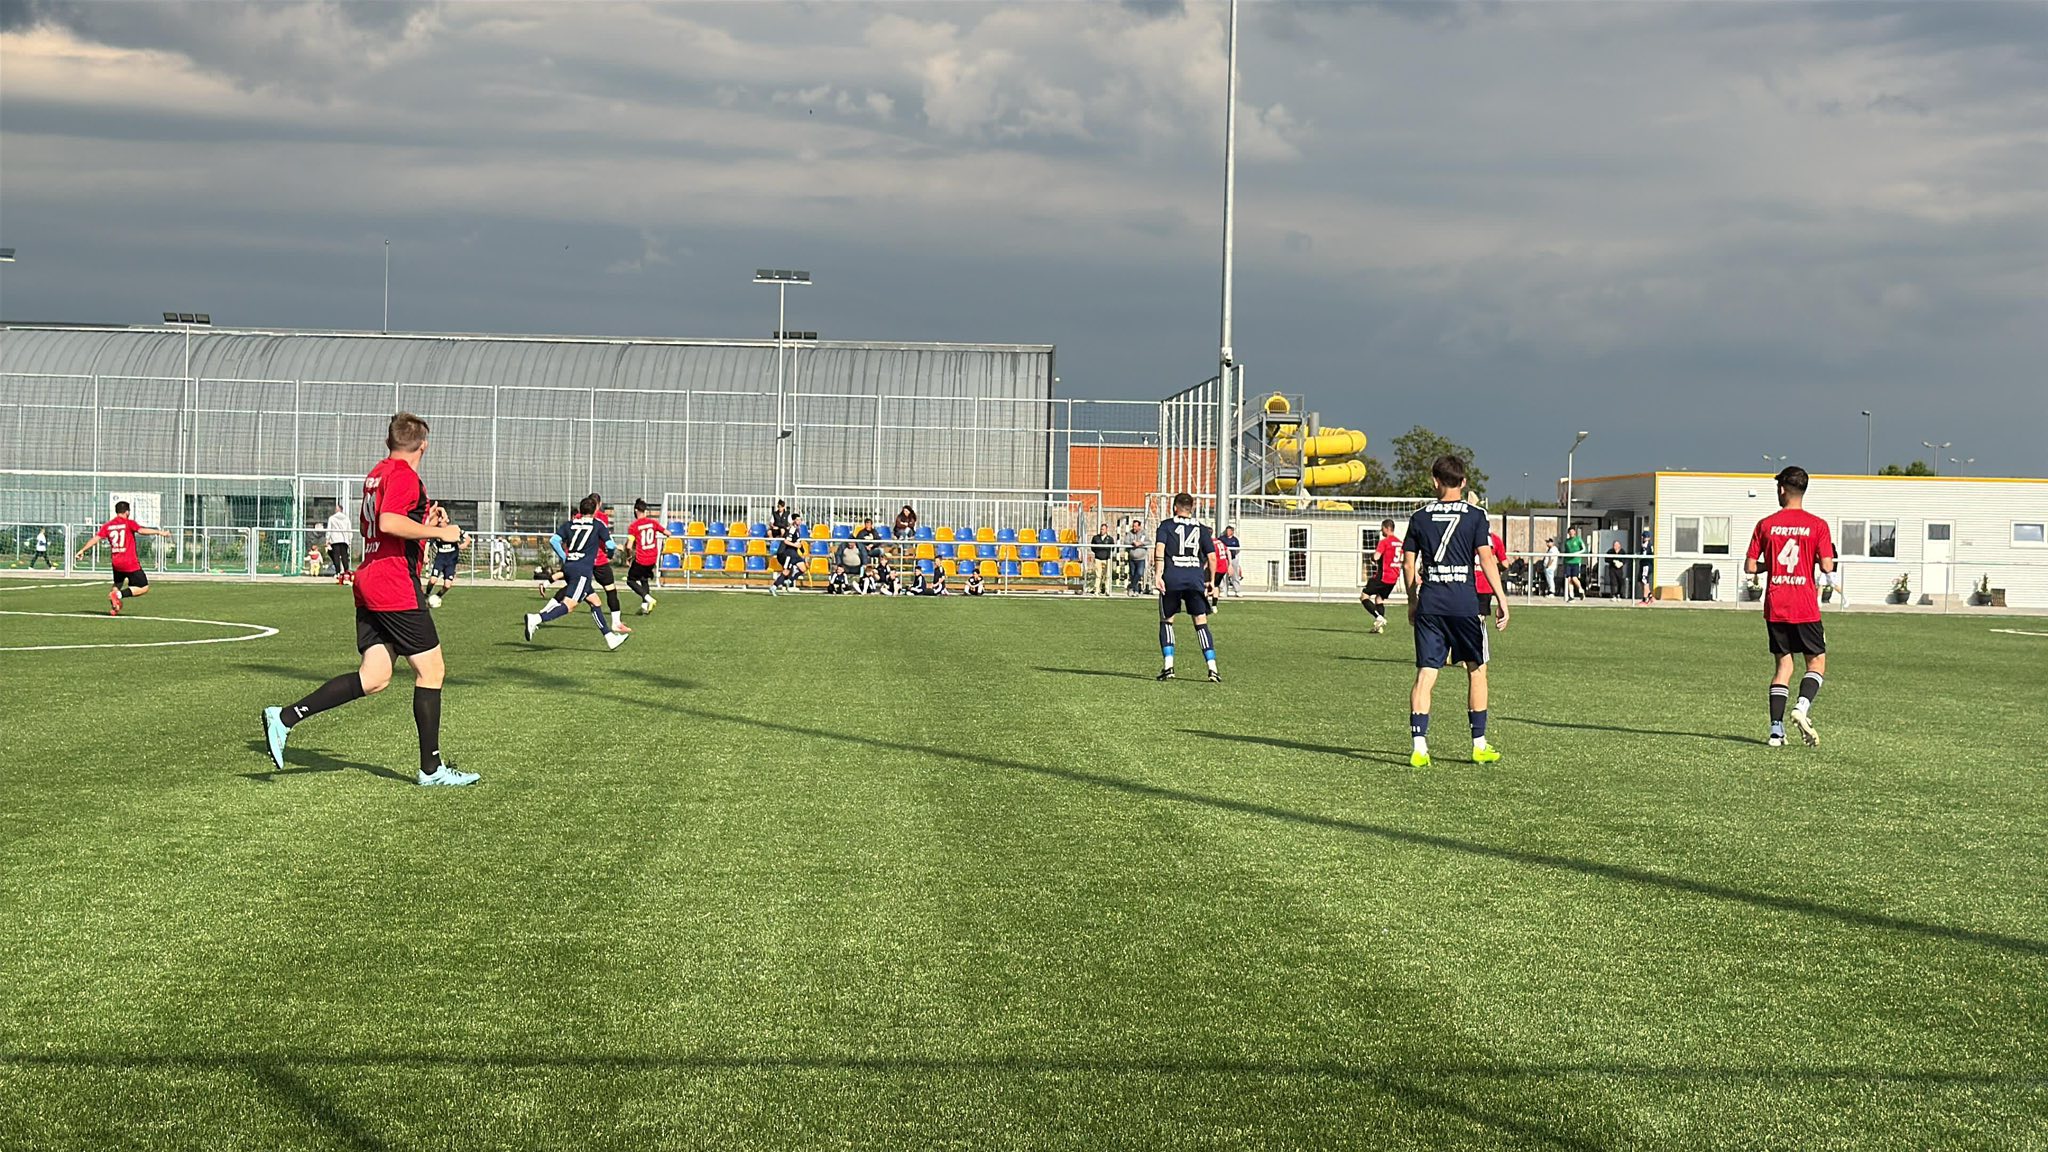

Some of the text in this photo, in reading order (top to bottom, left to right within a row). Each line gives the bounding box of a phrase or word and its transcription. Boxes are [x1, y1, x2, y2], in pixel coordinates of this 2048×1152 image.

[109, 529, 126, 548] 21
[569, 525, 594, 551] 77
[641, 528, 655, 546] 10
[1174, 525, 1201, 557] 14
[1432, 514, 1460, 562] 7
[1771, 526, 1810, 536] FORTUNA
[1777, 538, 1800, 574] 4
